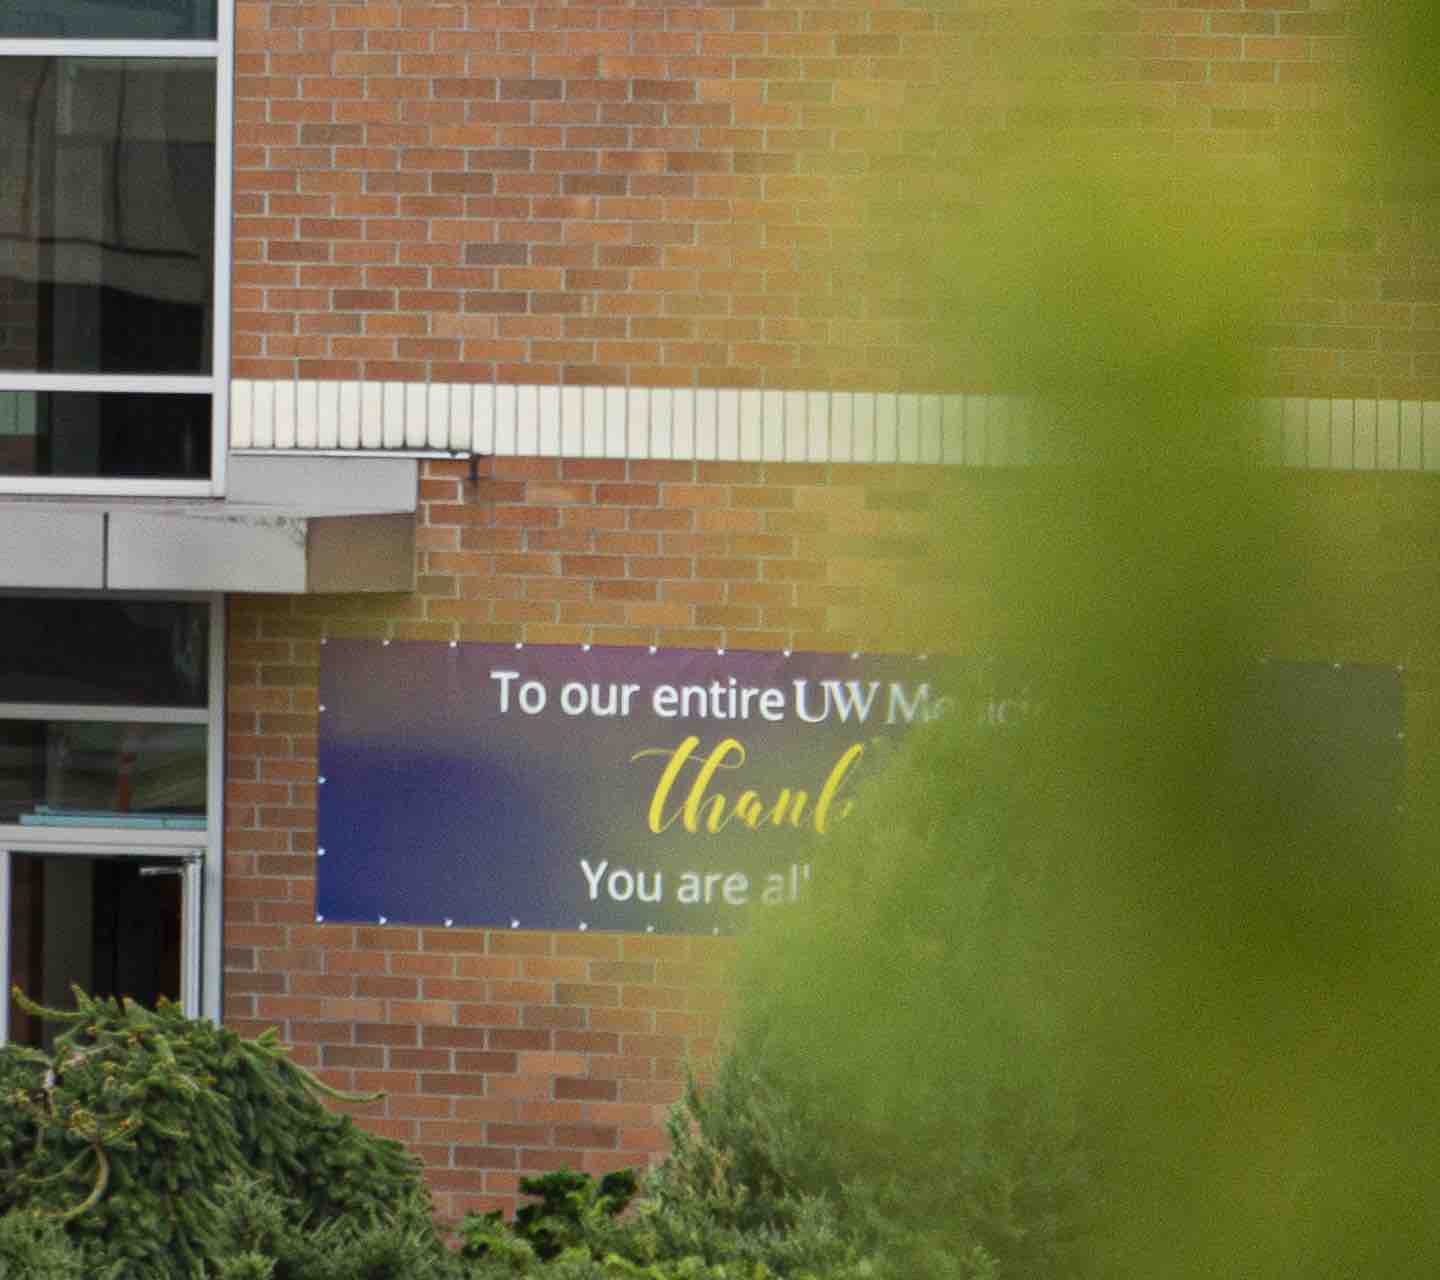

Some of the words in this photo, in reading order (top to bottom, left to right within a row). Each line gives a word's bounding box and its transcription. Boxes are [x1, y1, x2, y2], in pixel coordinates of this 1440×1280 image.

[489, 670, 547, 716] To
[560, 681, 641, 717] our
[652, 677, 786, 721] entire
[792, 679, 881, 724] UW
[580, 859, 662, 903] You
[676, 870, 749, 905] are
